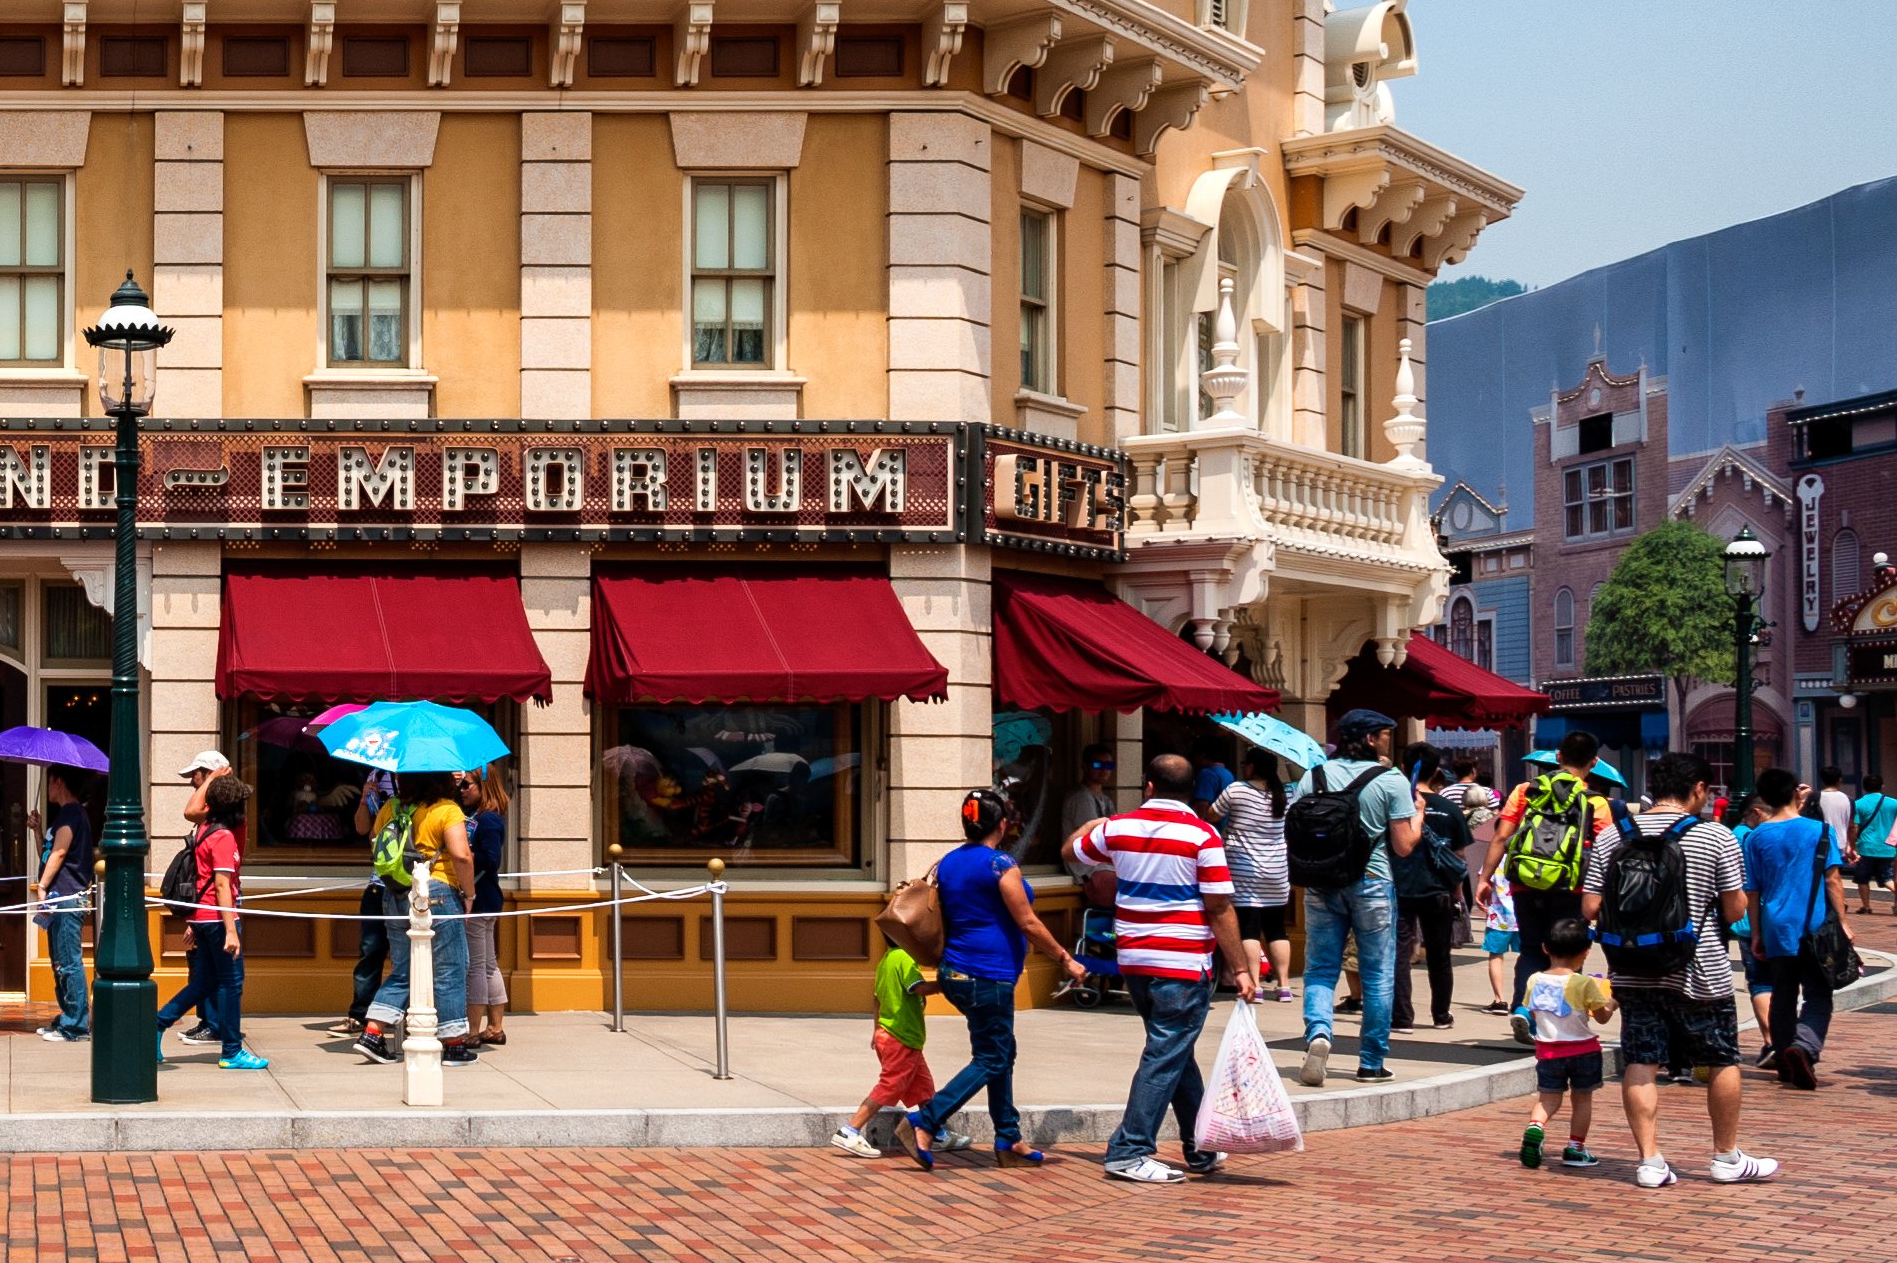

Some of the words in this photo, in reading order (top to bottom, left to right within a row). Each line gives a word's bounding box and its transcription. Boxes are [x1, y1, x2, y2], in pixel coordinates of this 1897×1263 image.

[261, 444, 908, 512] EMPORIUM
[995, 453, 1125, 532] GIFTS
[1804, 496, 1818, 611] JEWELRY
[1549, 688, 1581, 702] COFFEE
[1612, 683, 1656, 698] PASTRIES
